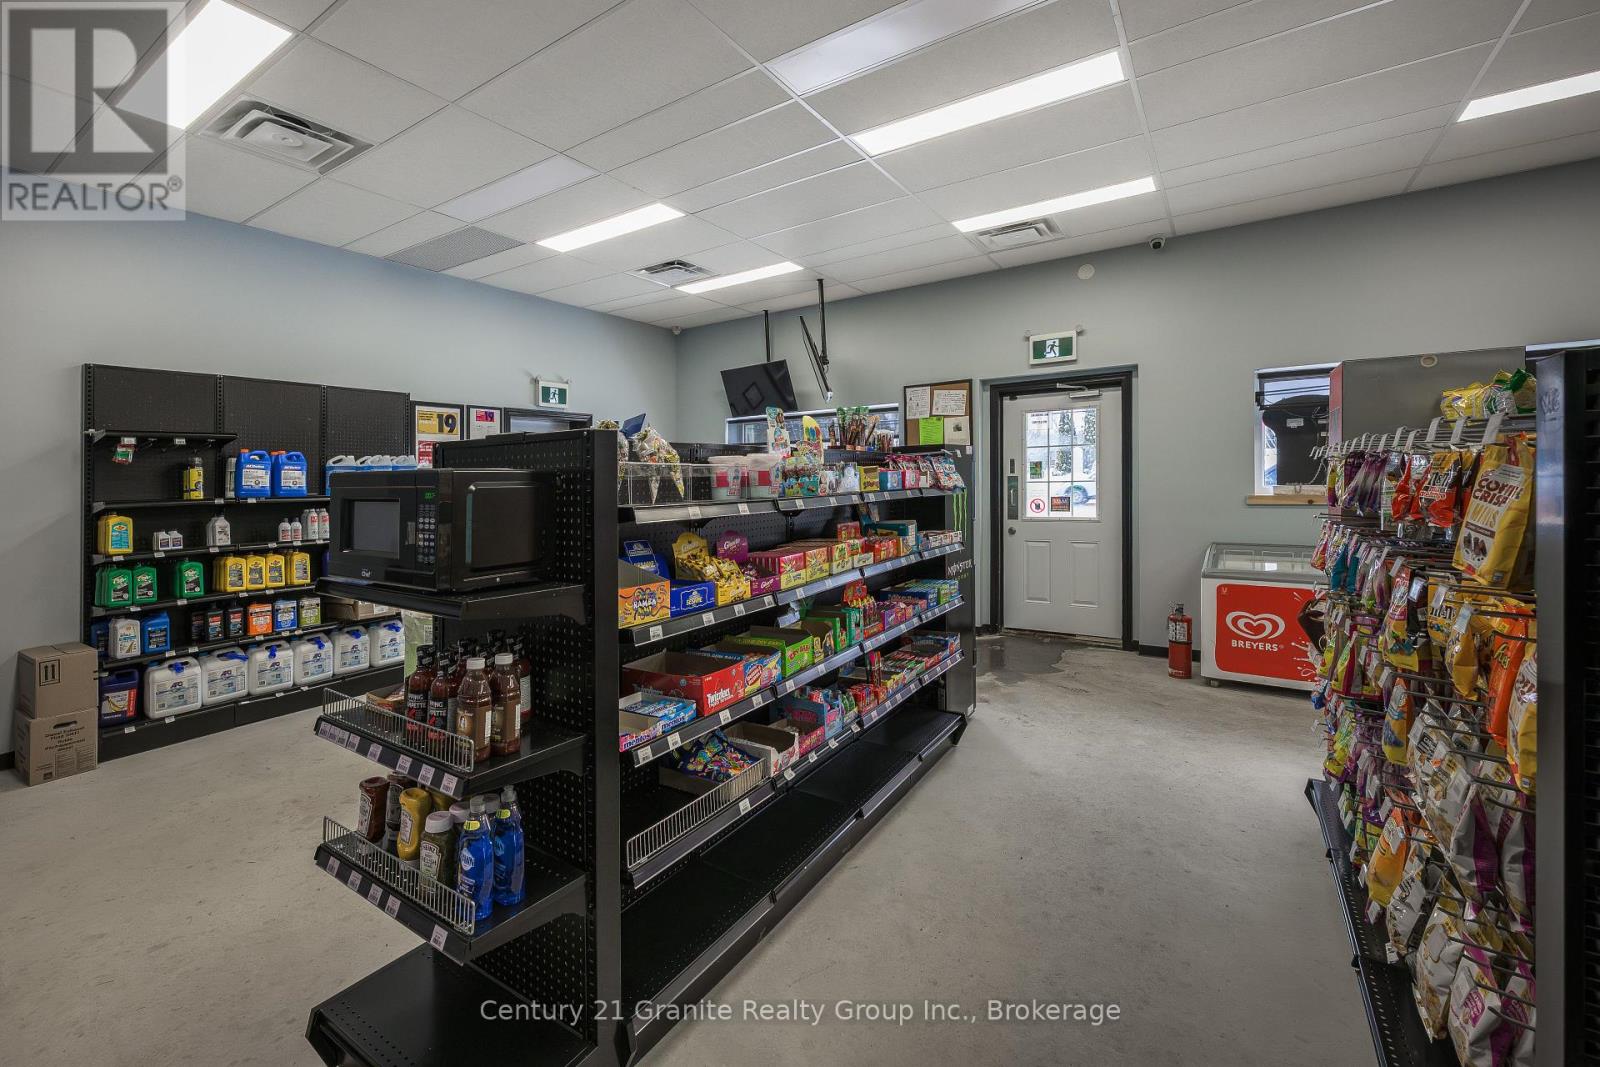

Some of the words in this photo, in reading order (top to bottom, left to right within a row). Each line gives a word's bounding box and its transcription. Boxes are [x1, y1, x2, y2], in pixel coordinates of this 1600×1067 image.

[436, 413, 457, 434] 19
[1231, 639, 1279, 652] BREYERS
[622, 732, 651, 750] mentos
